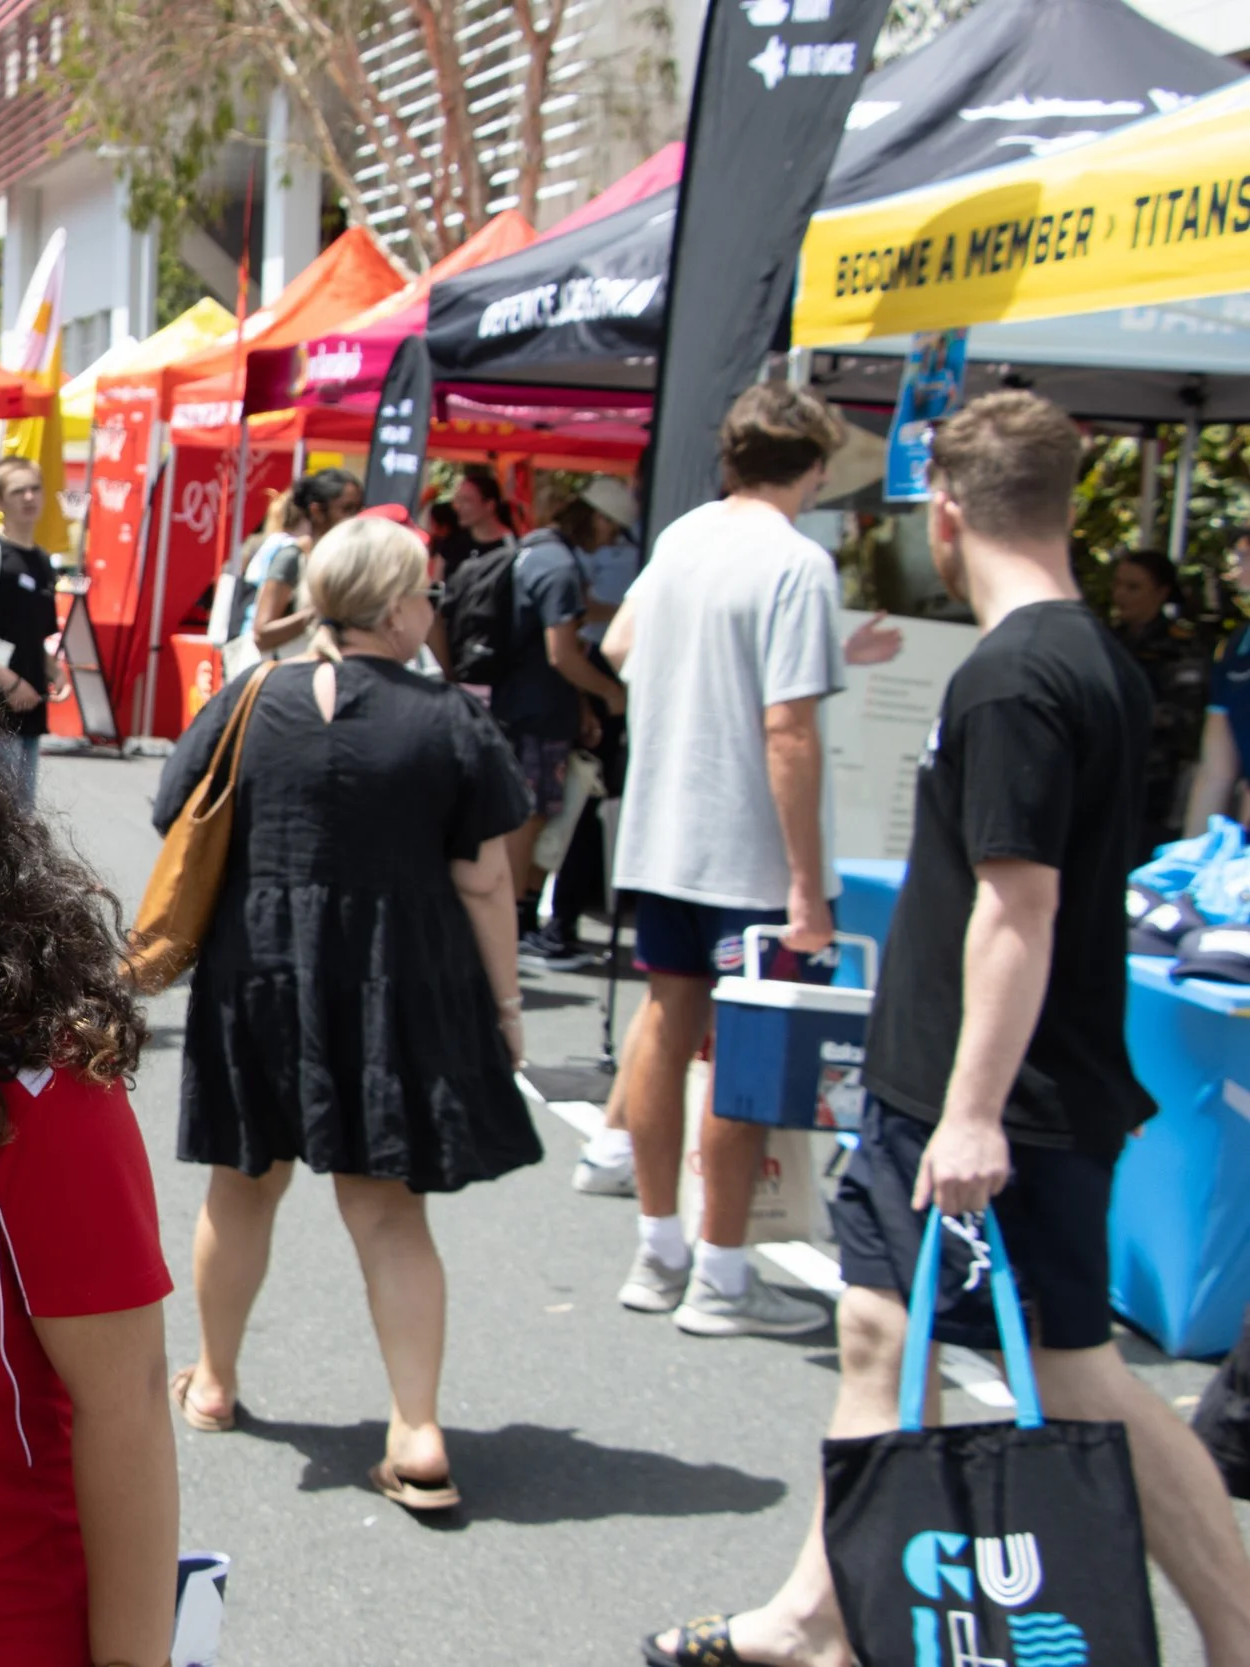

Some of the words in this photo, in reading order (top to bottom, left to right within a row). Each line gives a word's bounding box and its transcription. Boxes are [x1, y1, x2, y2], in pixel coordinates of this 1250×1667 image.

[835, 239, 932, 297] BECOME
[937, 232, 956, 283] A
[963, 207, 1095, 280] MEMBER
[1130, 174, 1250, 249] TITANS
